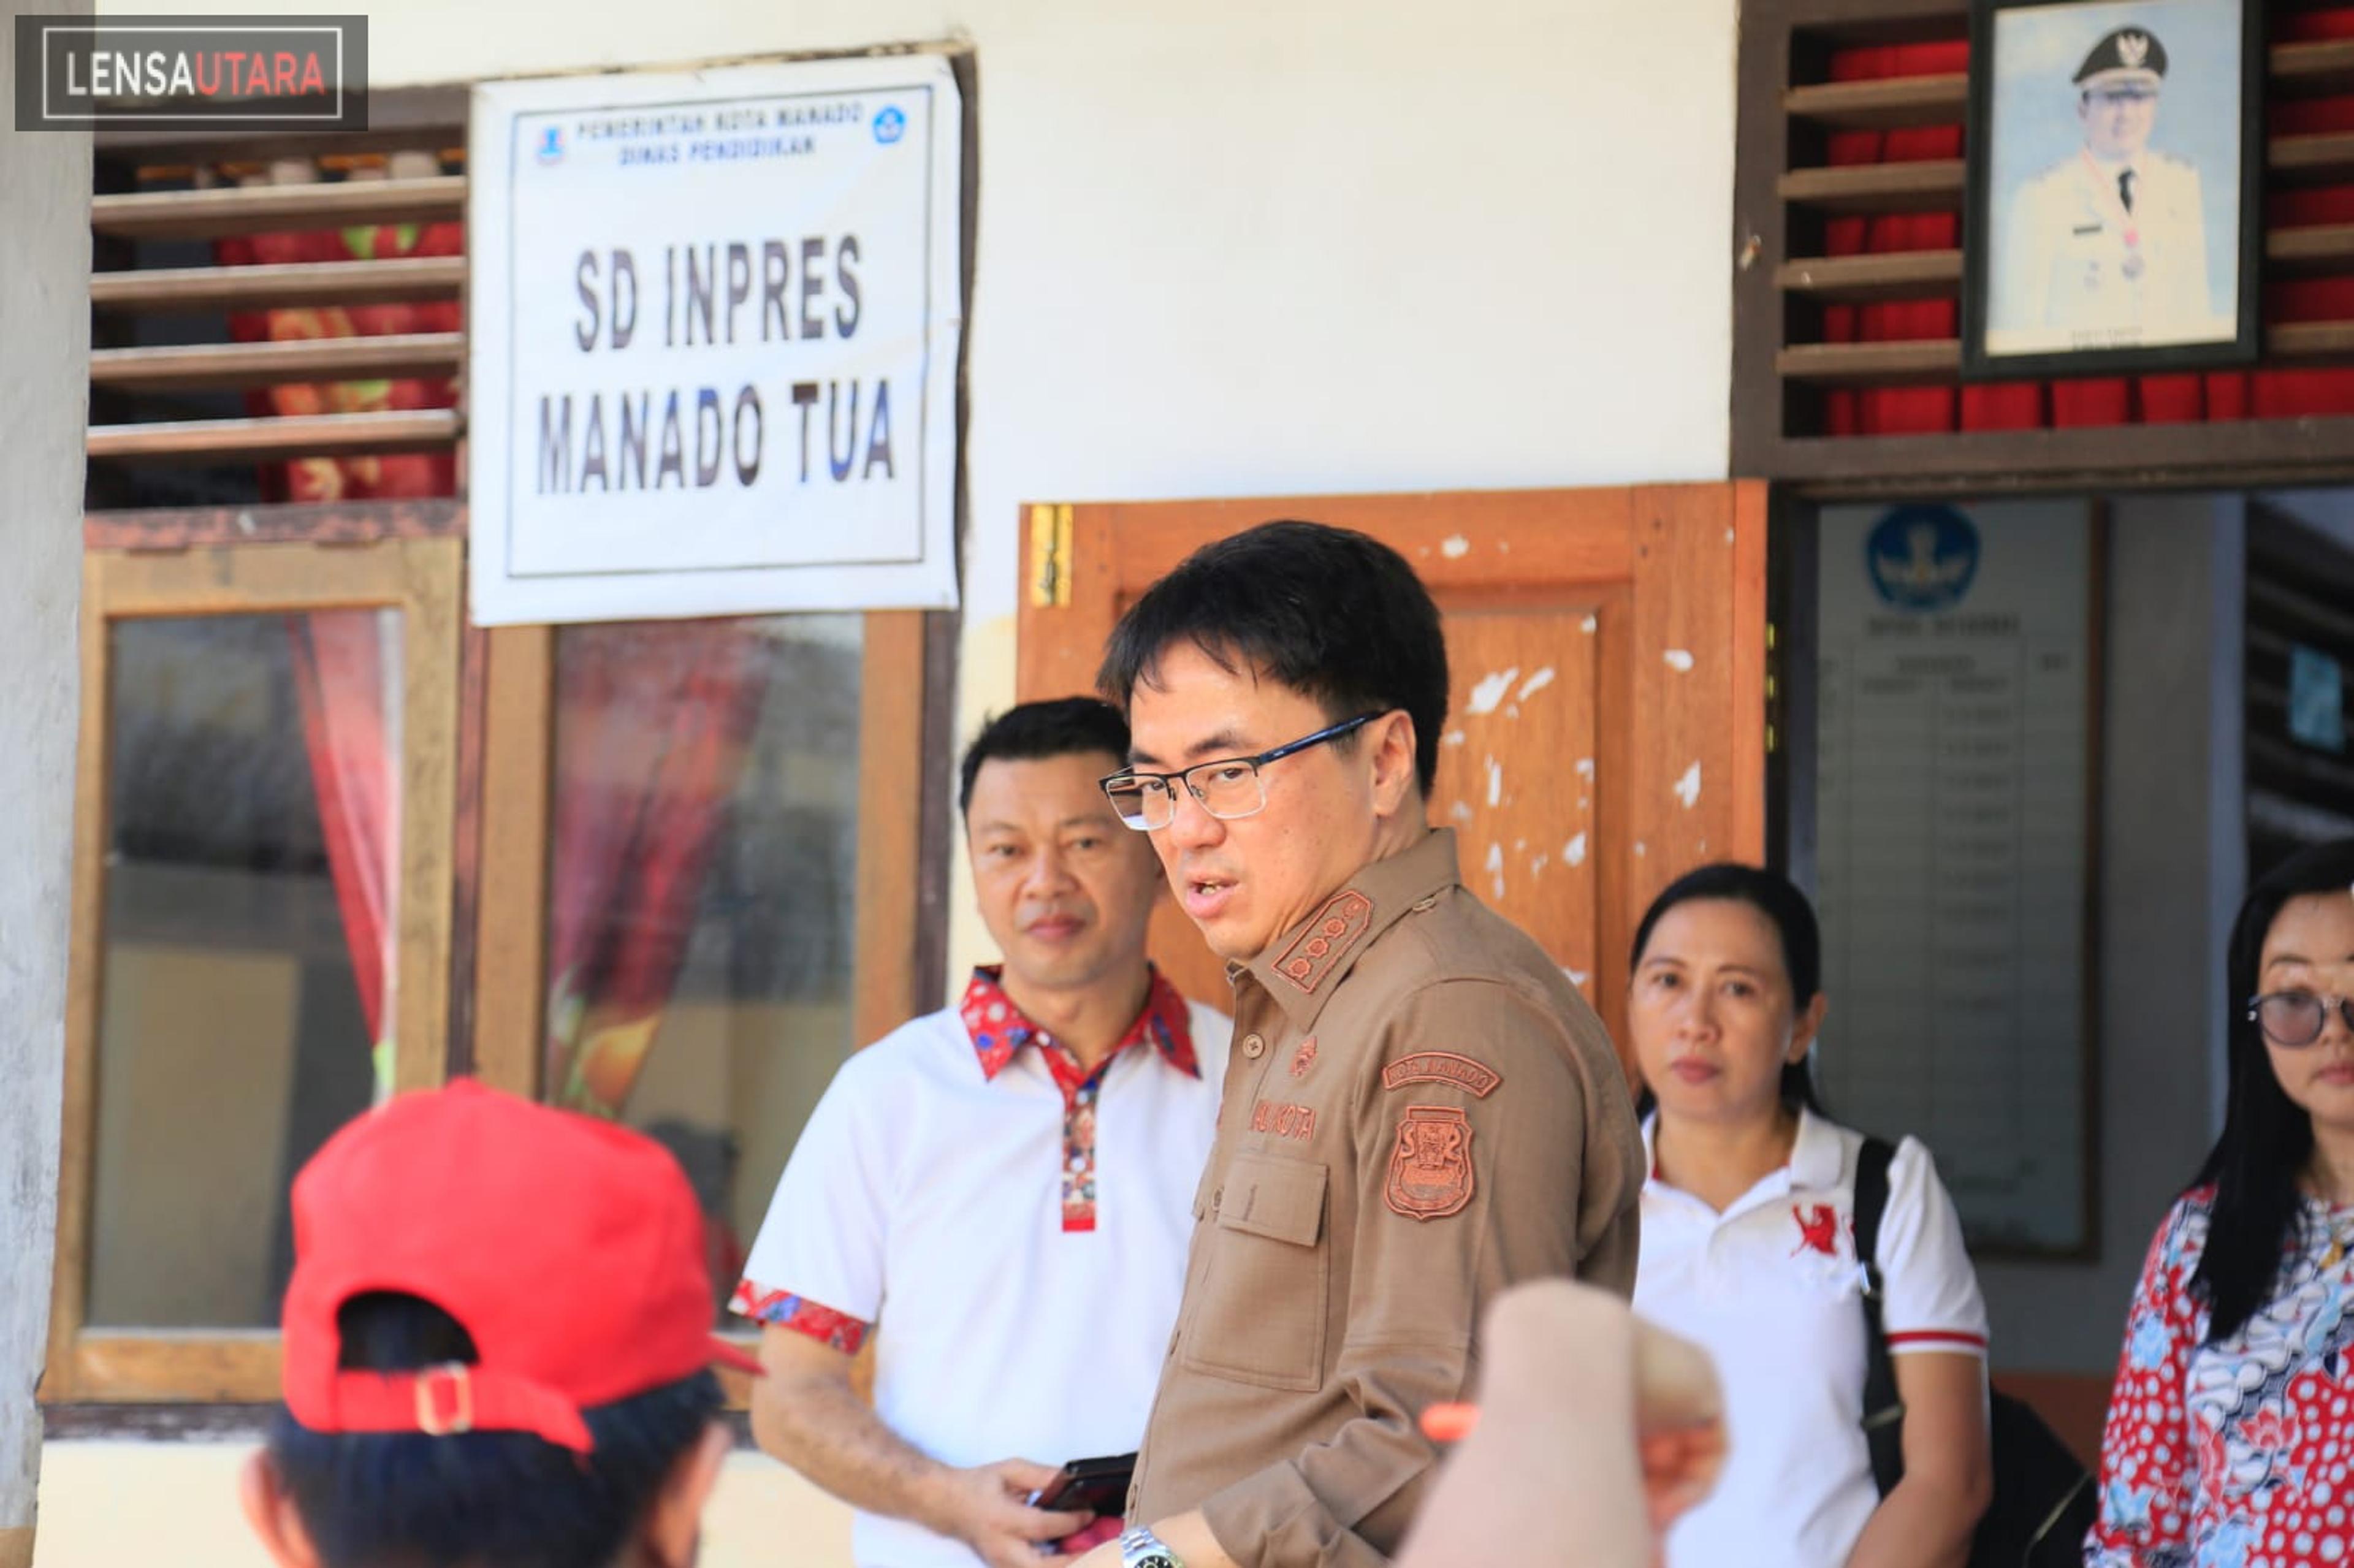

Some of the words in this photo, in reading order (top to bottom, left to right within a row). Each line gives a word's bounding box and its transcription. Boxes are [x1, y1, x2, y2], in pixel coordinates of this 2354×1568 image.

[576, 113, 703, 141] PEMERINTAH
[715, 108, 766, 131] KOTA
[777, 101, 861, 127] MANADO
[620, 143, 679, 166] DINAS
[691, 135, 814, 162] PENDIDIKAN
[576, 248, 637, 351] SD
[667, 235, 859, 347] INPRES
[538, 384, 763, 494] MANADO
[791, 379, 895, 483] TUA
